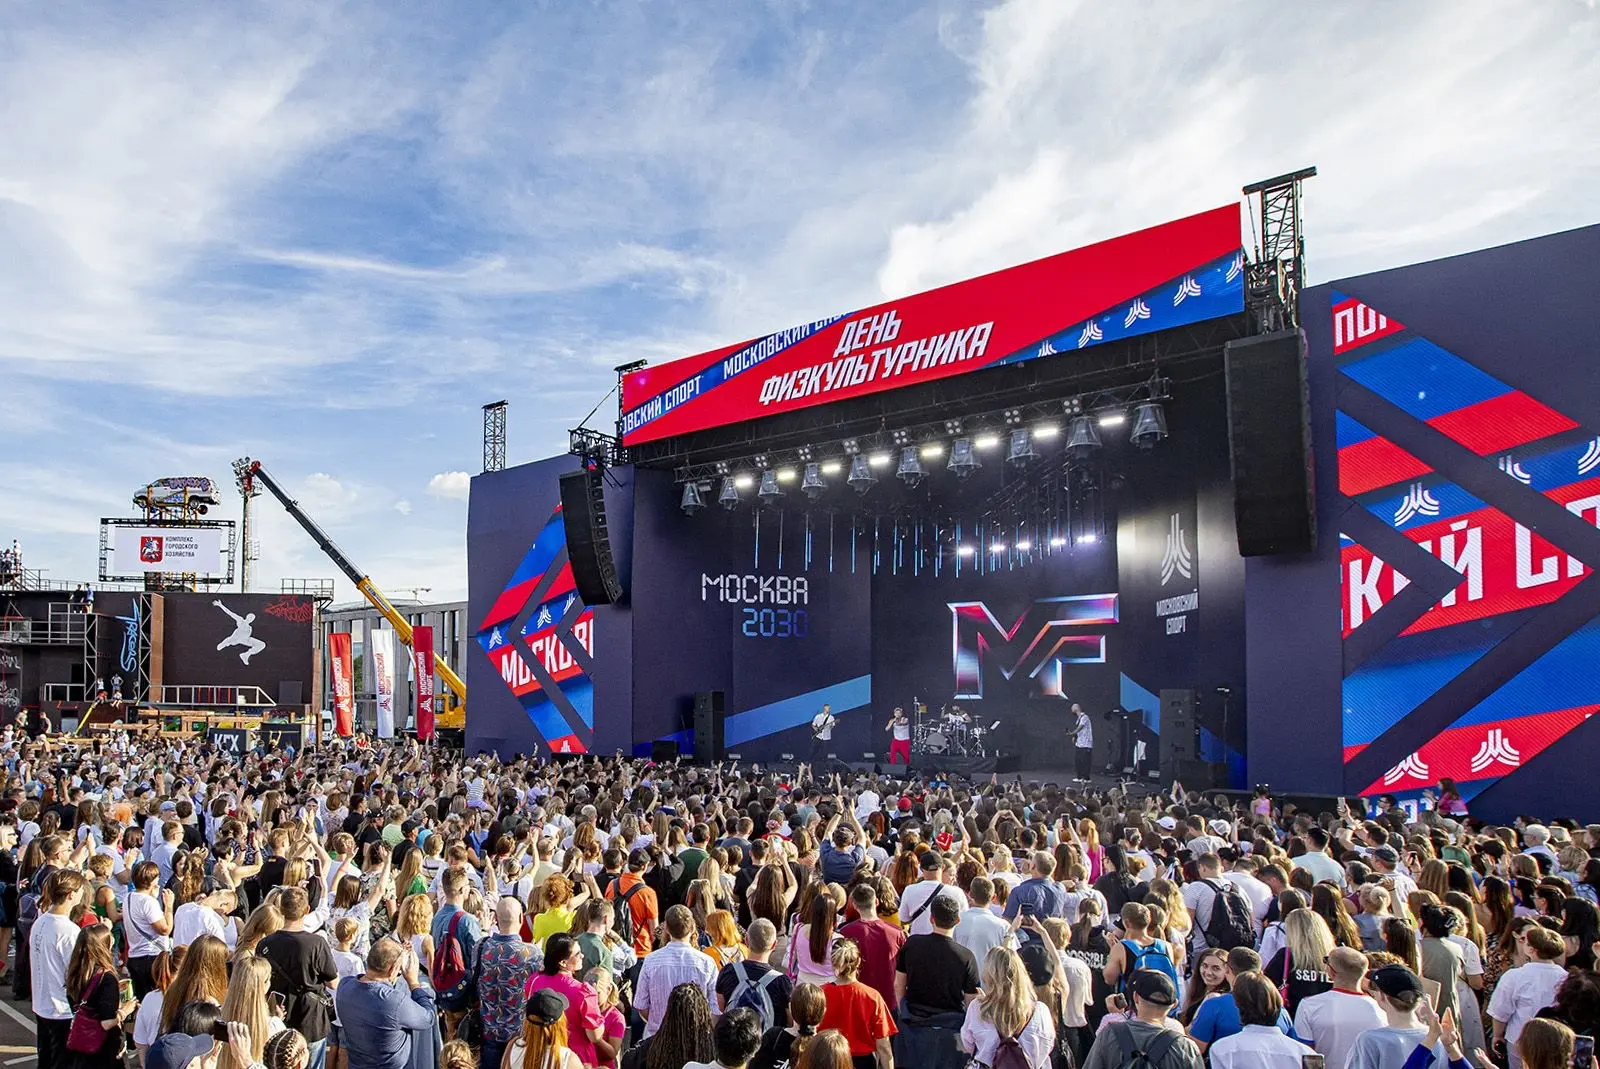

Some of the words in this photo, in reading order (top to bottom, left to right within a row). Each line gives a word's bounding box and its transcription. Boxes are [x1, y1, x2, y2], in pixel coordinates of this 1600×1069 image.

[832, 310, 903, 359] ДЕНЬ
[758, 321, 995, 406] ФИЗКУЛЬТУРНИКА
[665, 375, 702, 411] СПОРТ
[702, 573, 808, 605] МОСКВА
[742, 608, 808, 637] 2030
[416, 651, 428, 696] МОСКОВСКИЙ
[1295, 969, 1317, 982] S&D
